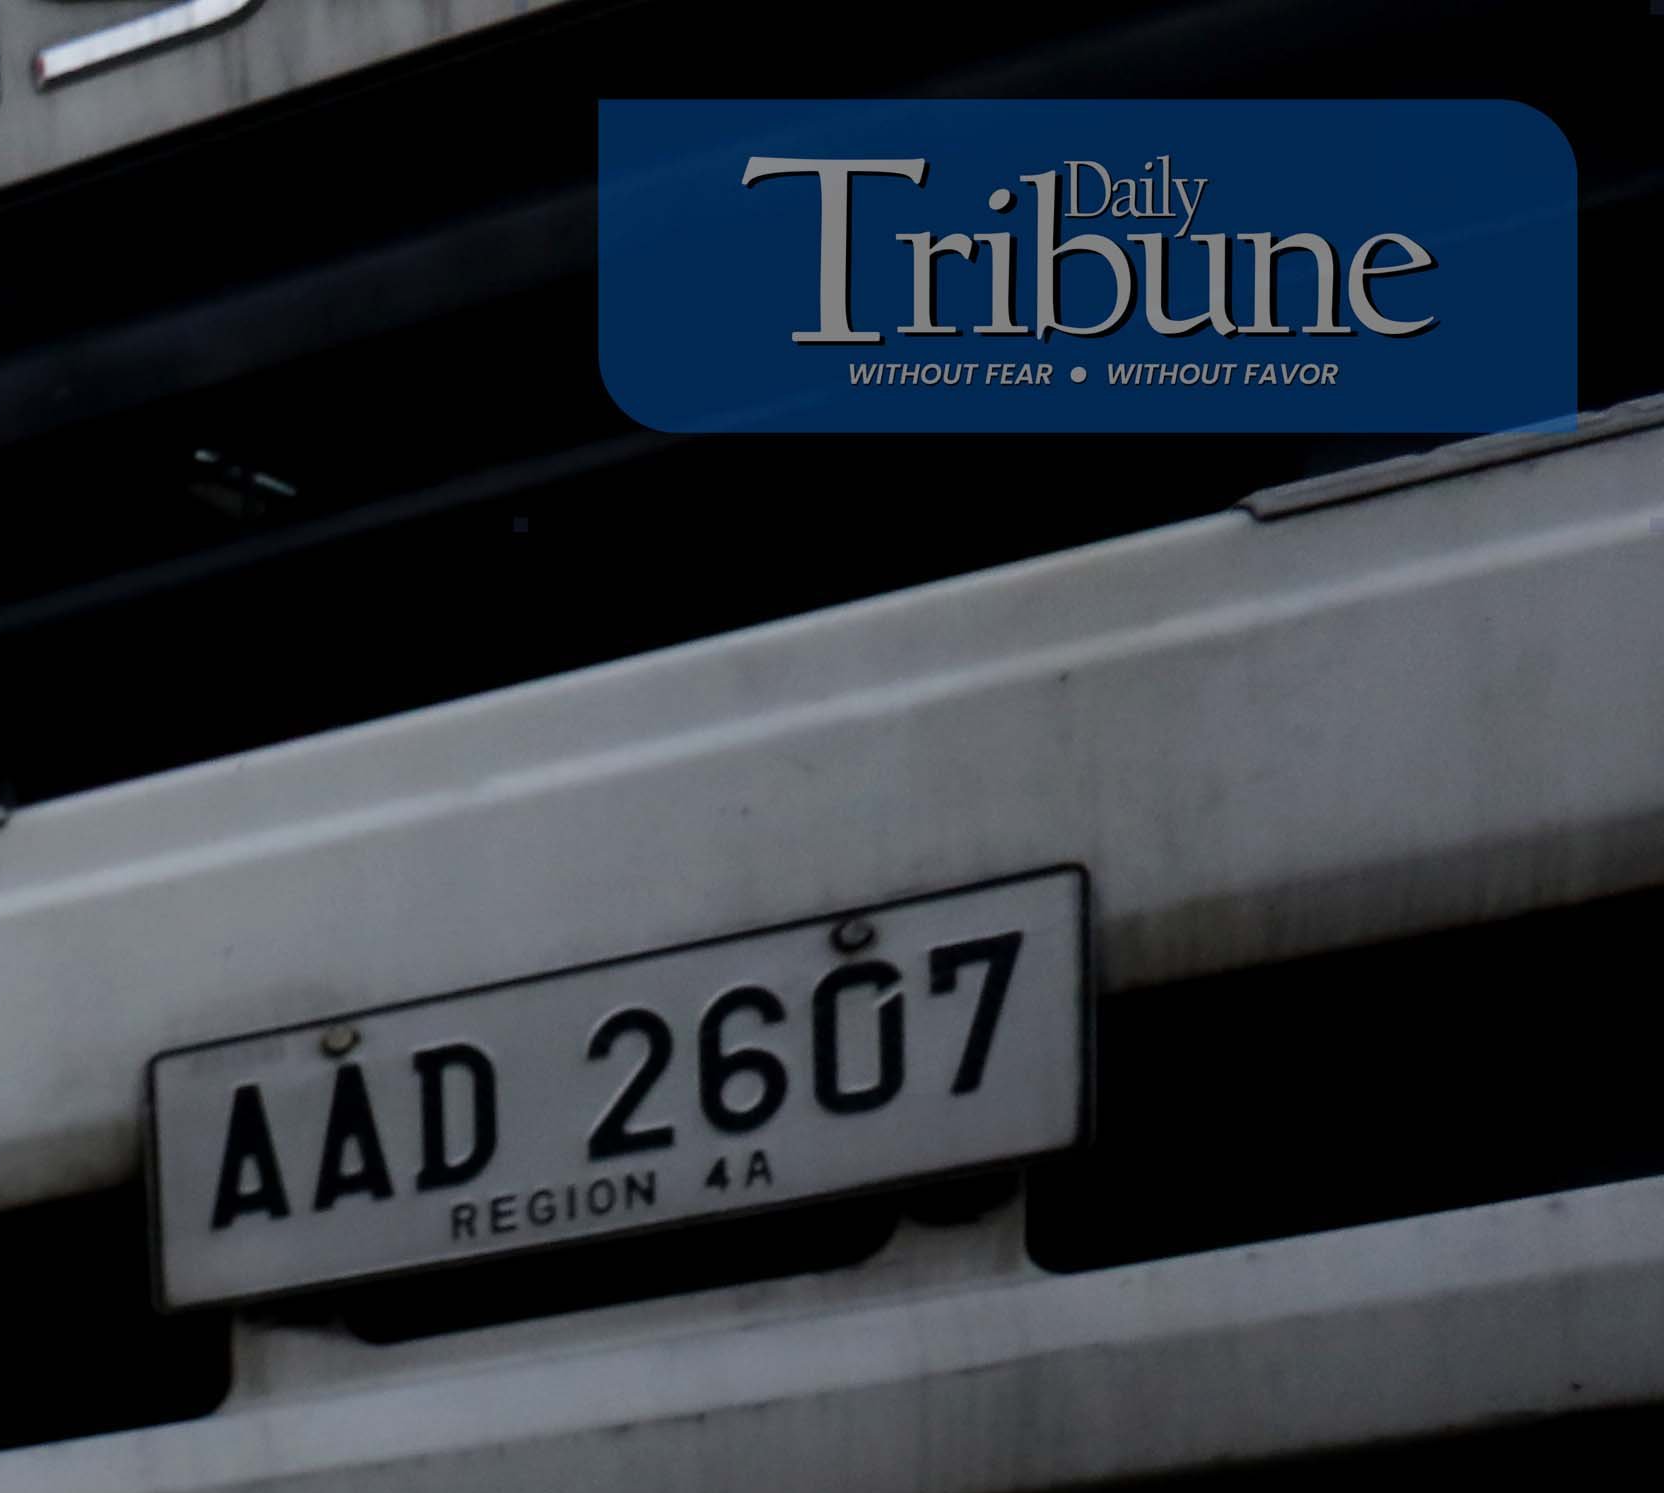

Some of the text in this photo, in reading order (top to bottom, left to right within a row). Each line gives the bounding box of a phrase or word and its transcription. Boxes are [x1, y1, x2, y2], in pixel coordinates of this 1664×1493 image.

[210, 930, 1024, 1231] AAD 2607
[450, 1149, 775, 1242] REGION 4A
